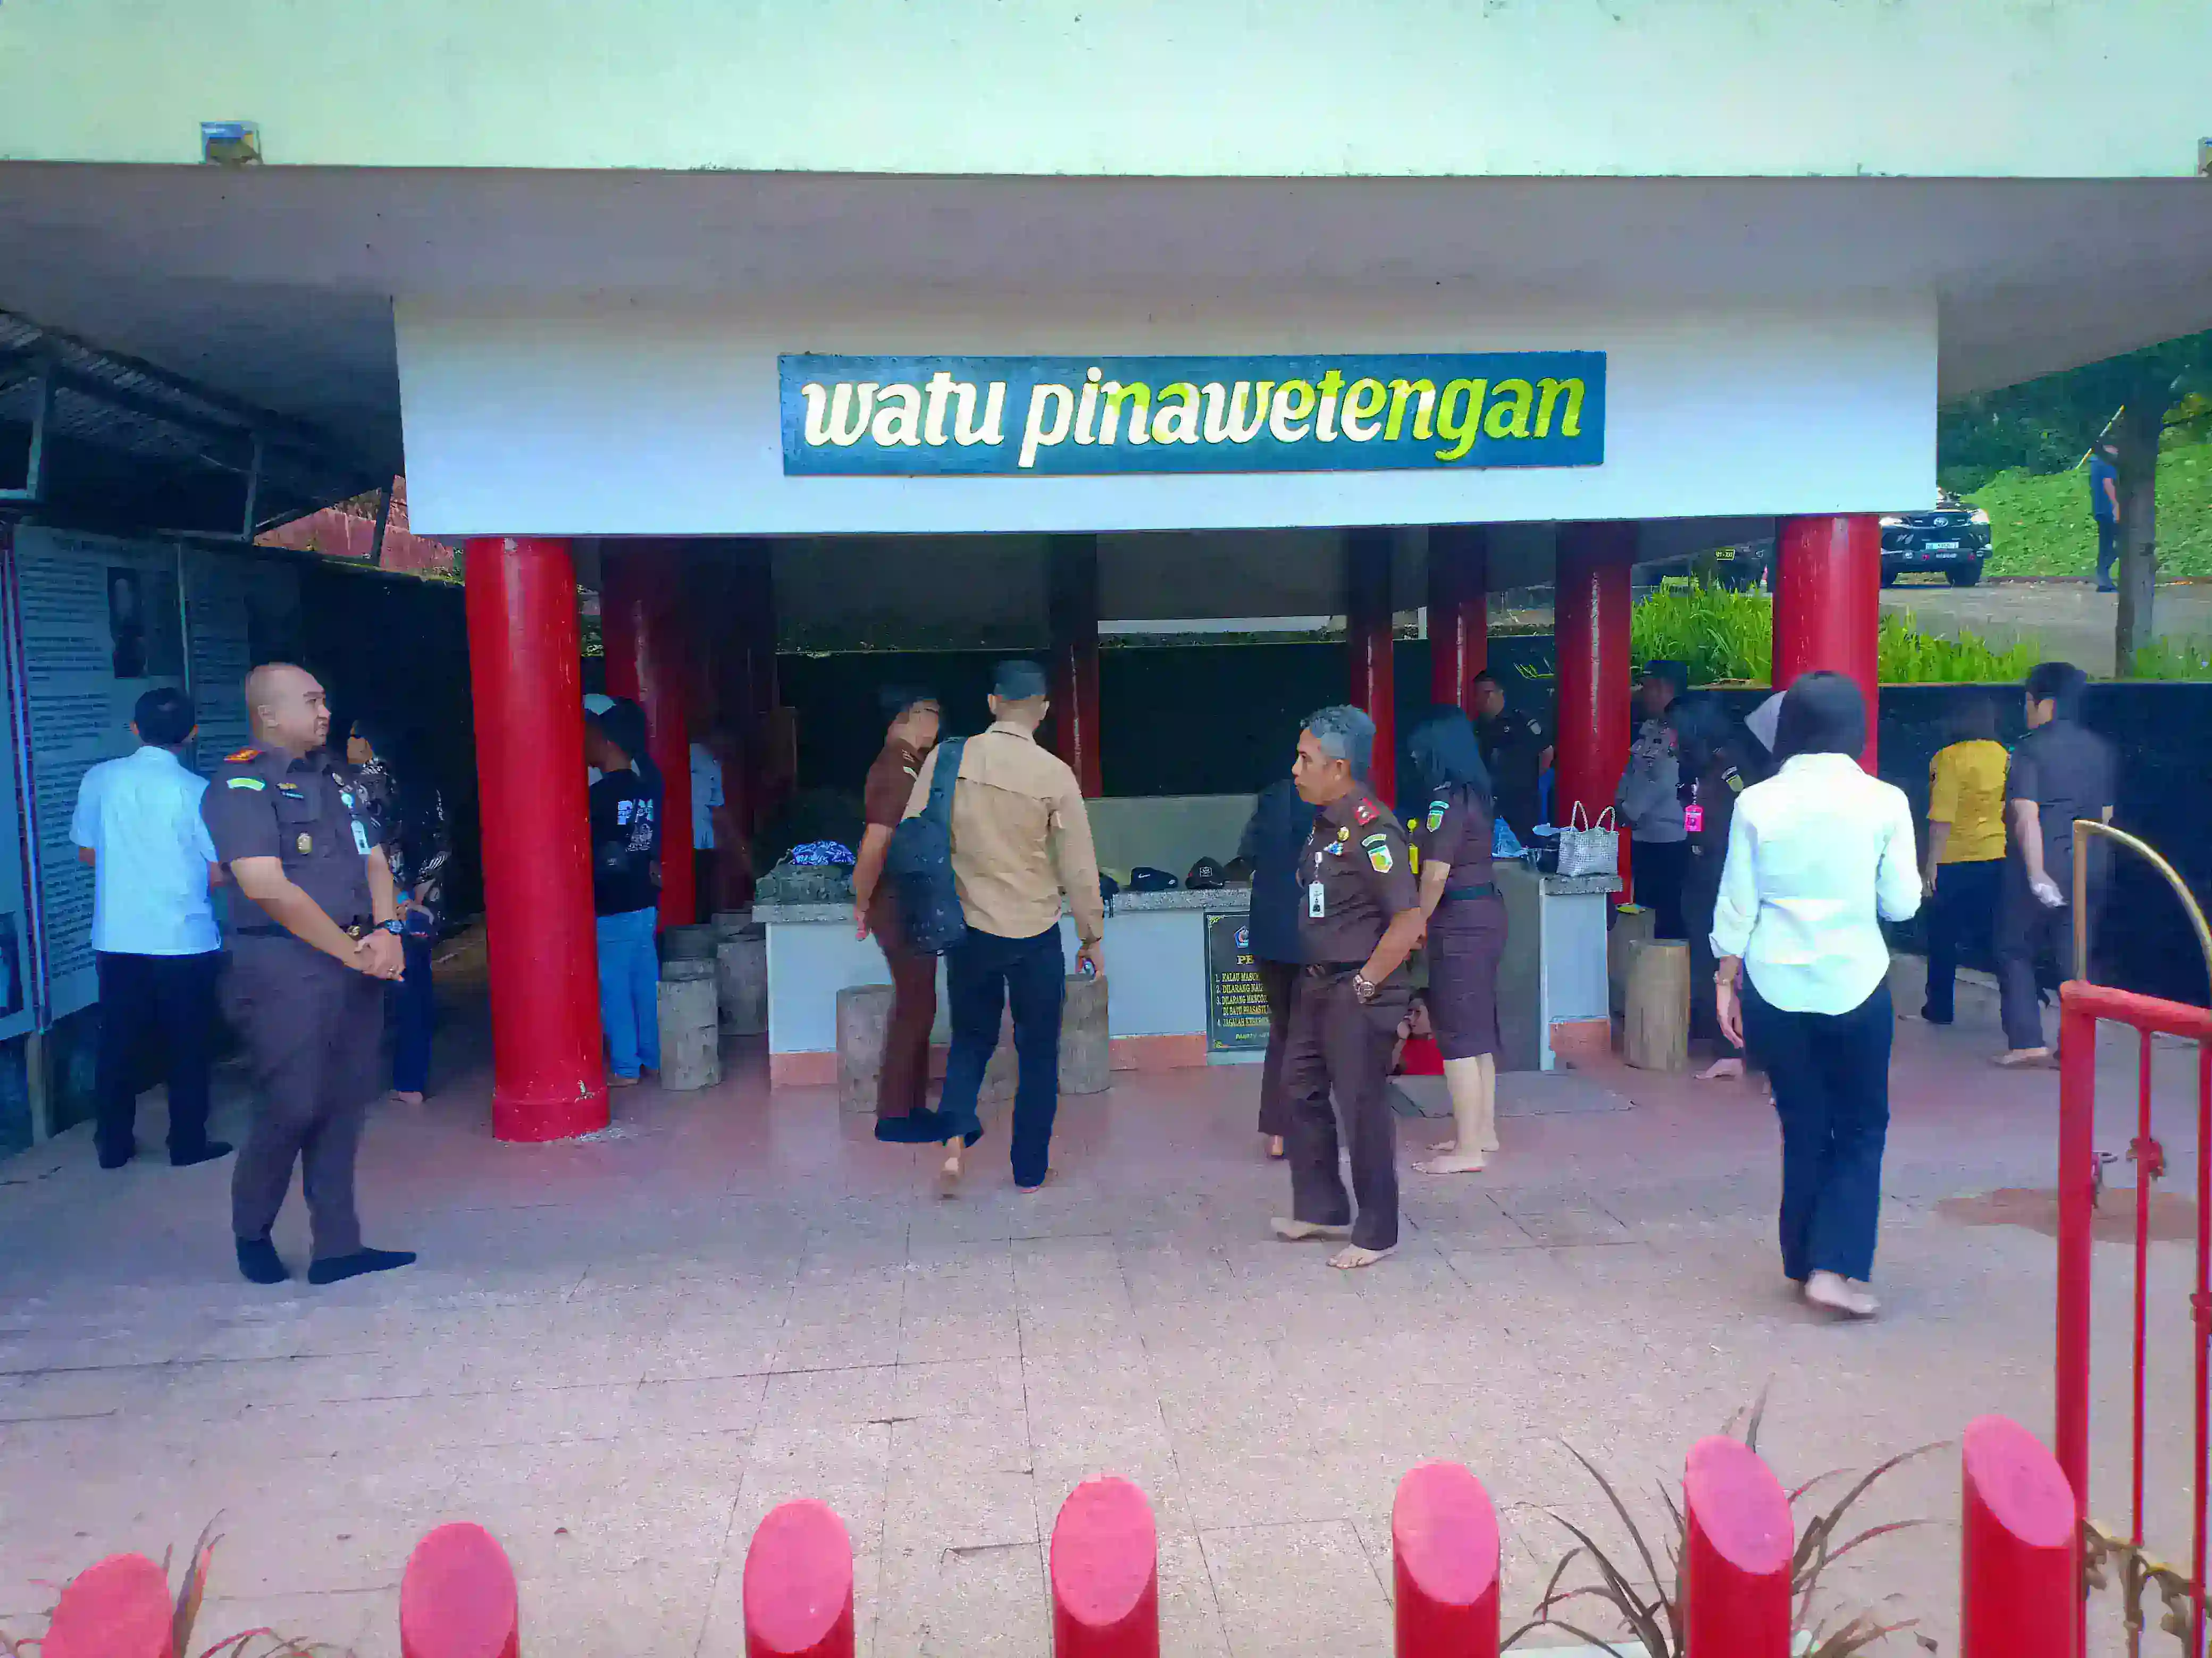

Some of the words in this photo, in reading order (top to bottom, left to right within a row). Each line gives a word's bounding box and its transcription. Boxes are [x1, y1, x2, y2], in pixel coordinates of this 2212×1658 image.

[801, 371, 1007, 447] watu
[1017, 367, 1585, 468] pinawetengan
[1222, 973, 1240, 982] KALAU
[1222, 984, 1250, 993] DILARANG
[1222, 995, 1246, 1005] DILARANG
